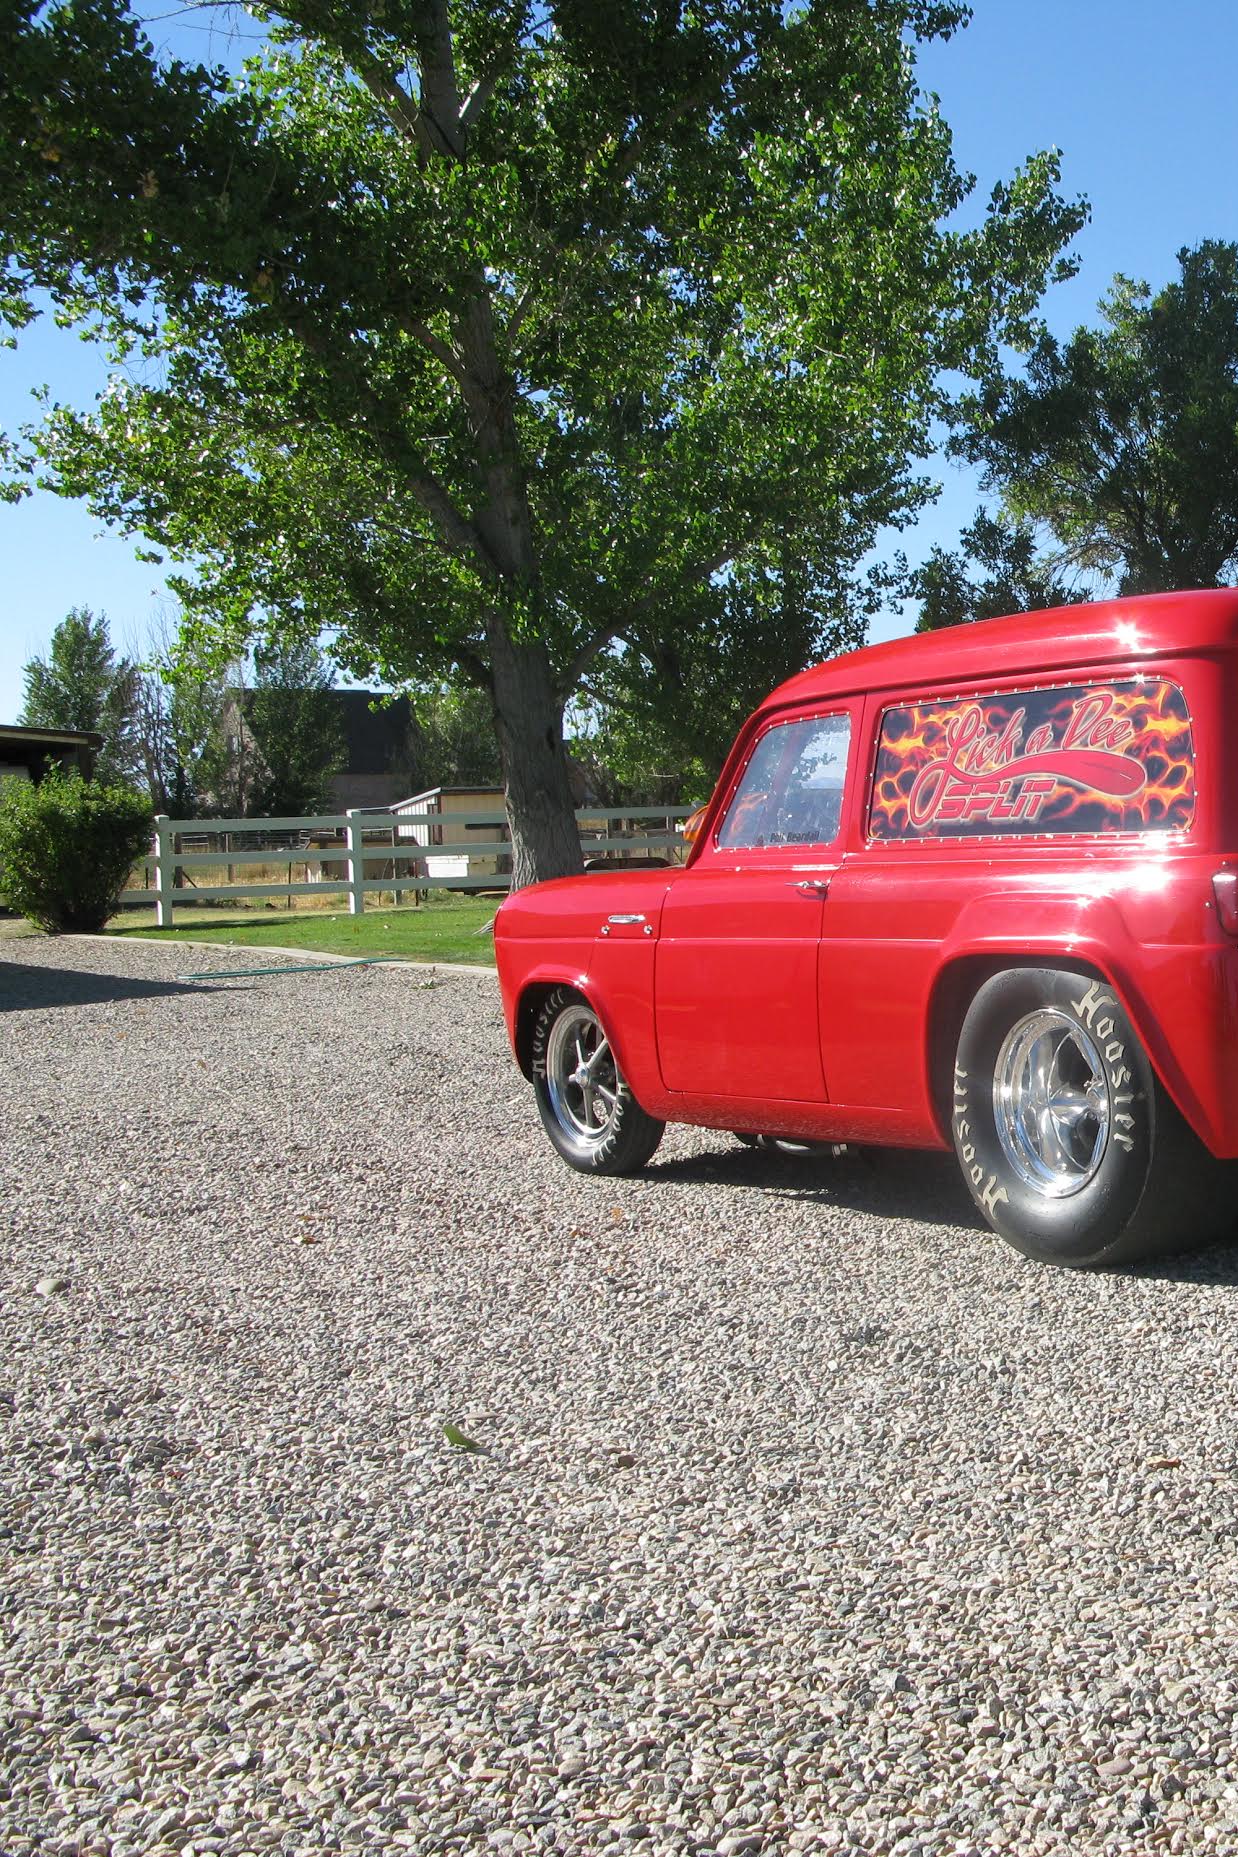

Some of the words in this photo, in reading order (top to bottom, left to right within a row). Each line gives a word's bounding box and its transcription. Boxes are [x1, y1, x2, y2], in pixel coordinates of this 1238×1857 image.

[947, 707, 1026, 772] Lick
[1026, 724, 1052, 755] a
[1062, 693, 1133, 751] Dee
[934, 779, 1057, 821] SPLIT
